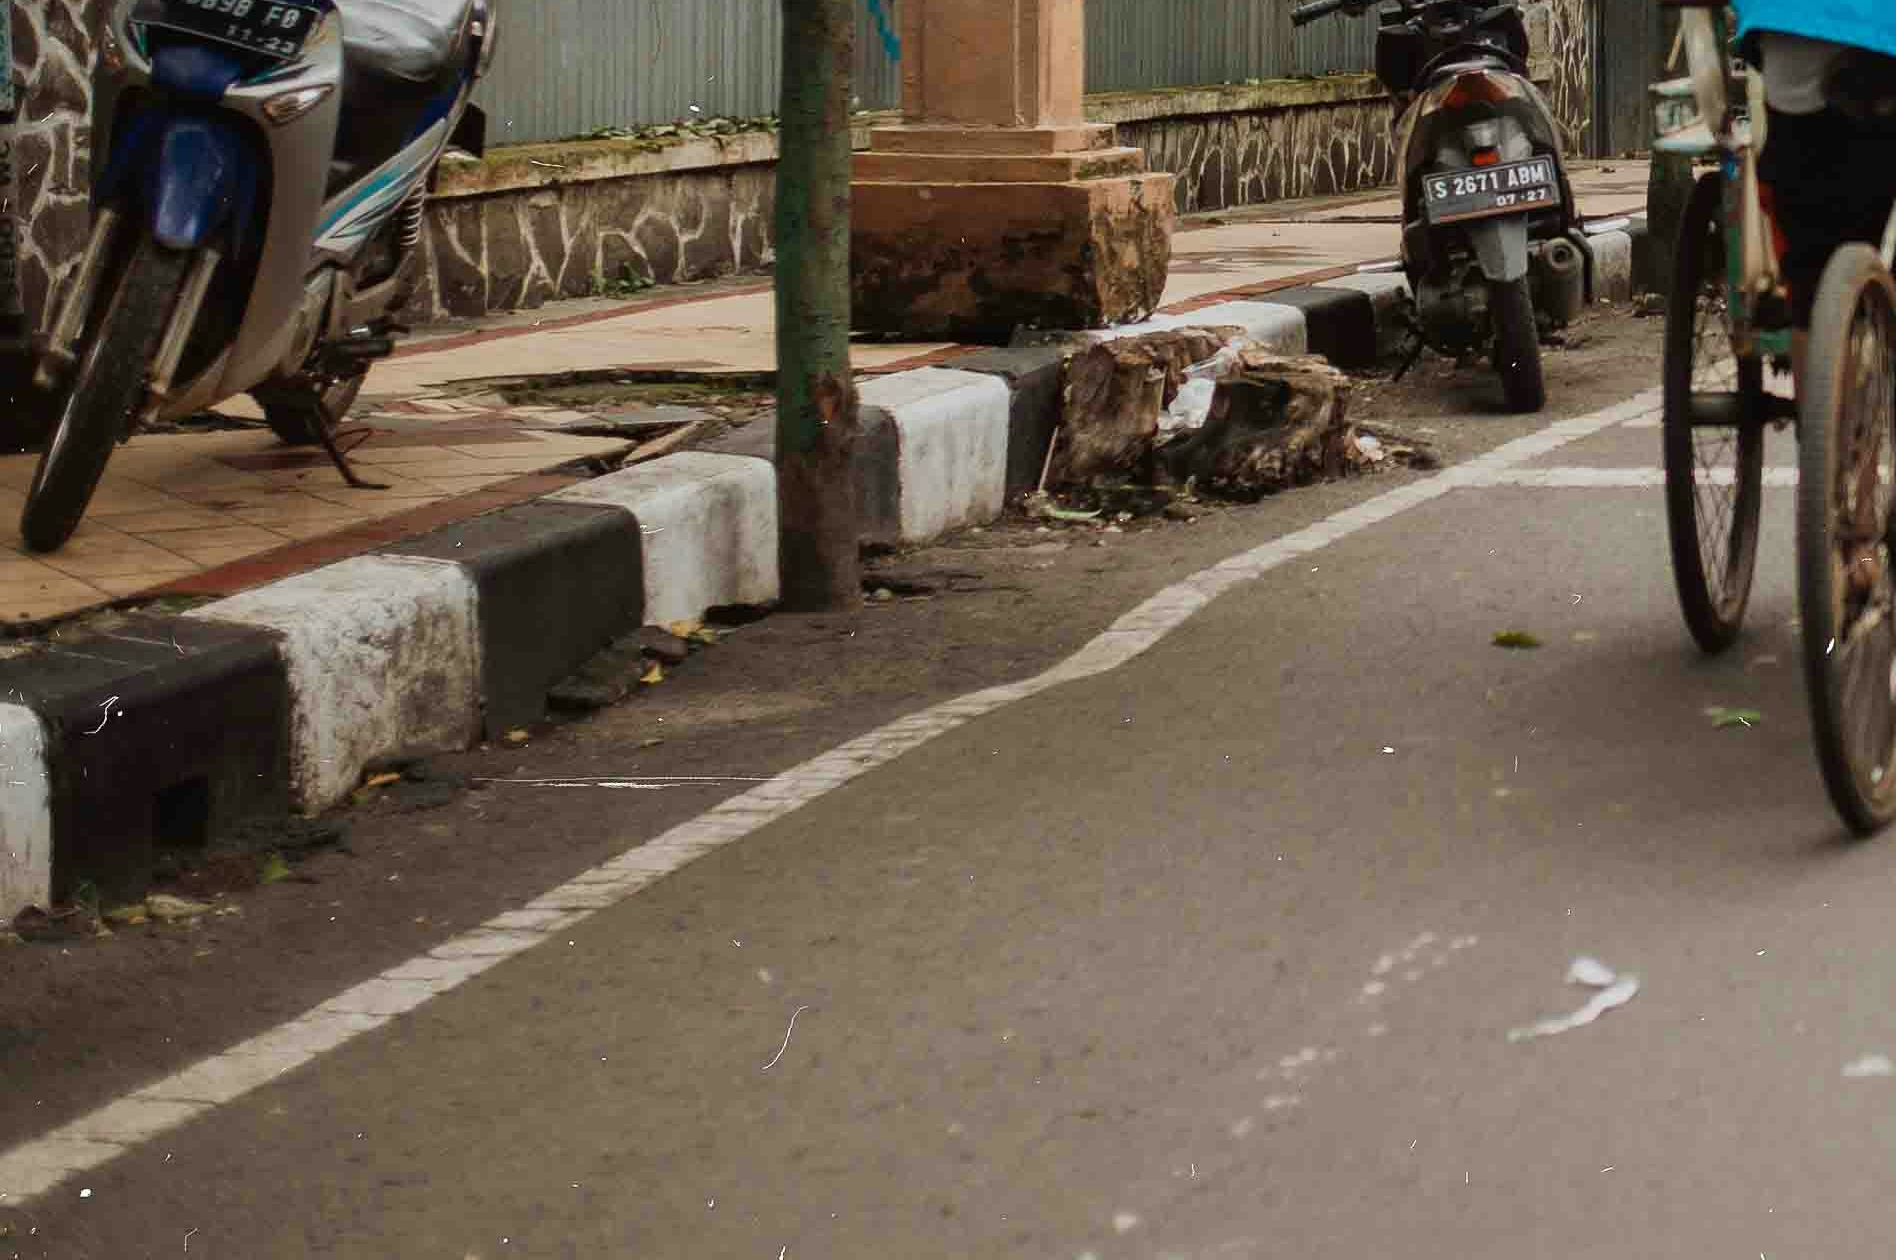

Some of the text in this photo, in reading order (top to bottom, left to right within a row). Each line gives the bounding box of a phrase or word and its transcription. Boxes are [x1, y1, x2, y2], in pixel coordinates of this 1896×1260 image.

[1434, 164, 1545, 199] S 2671 ABM
